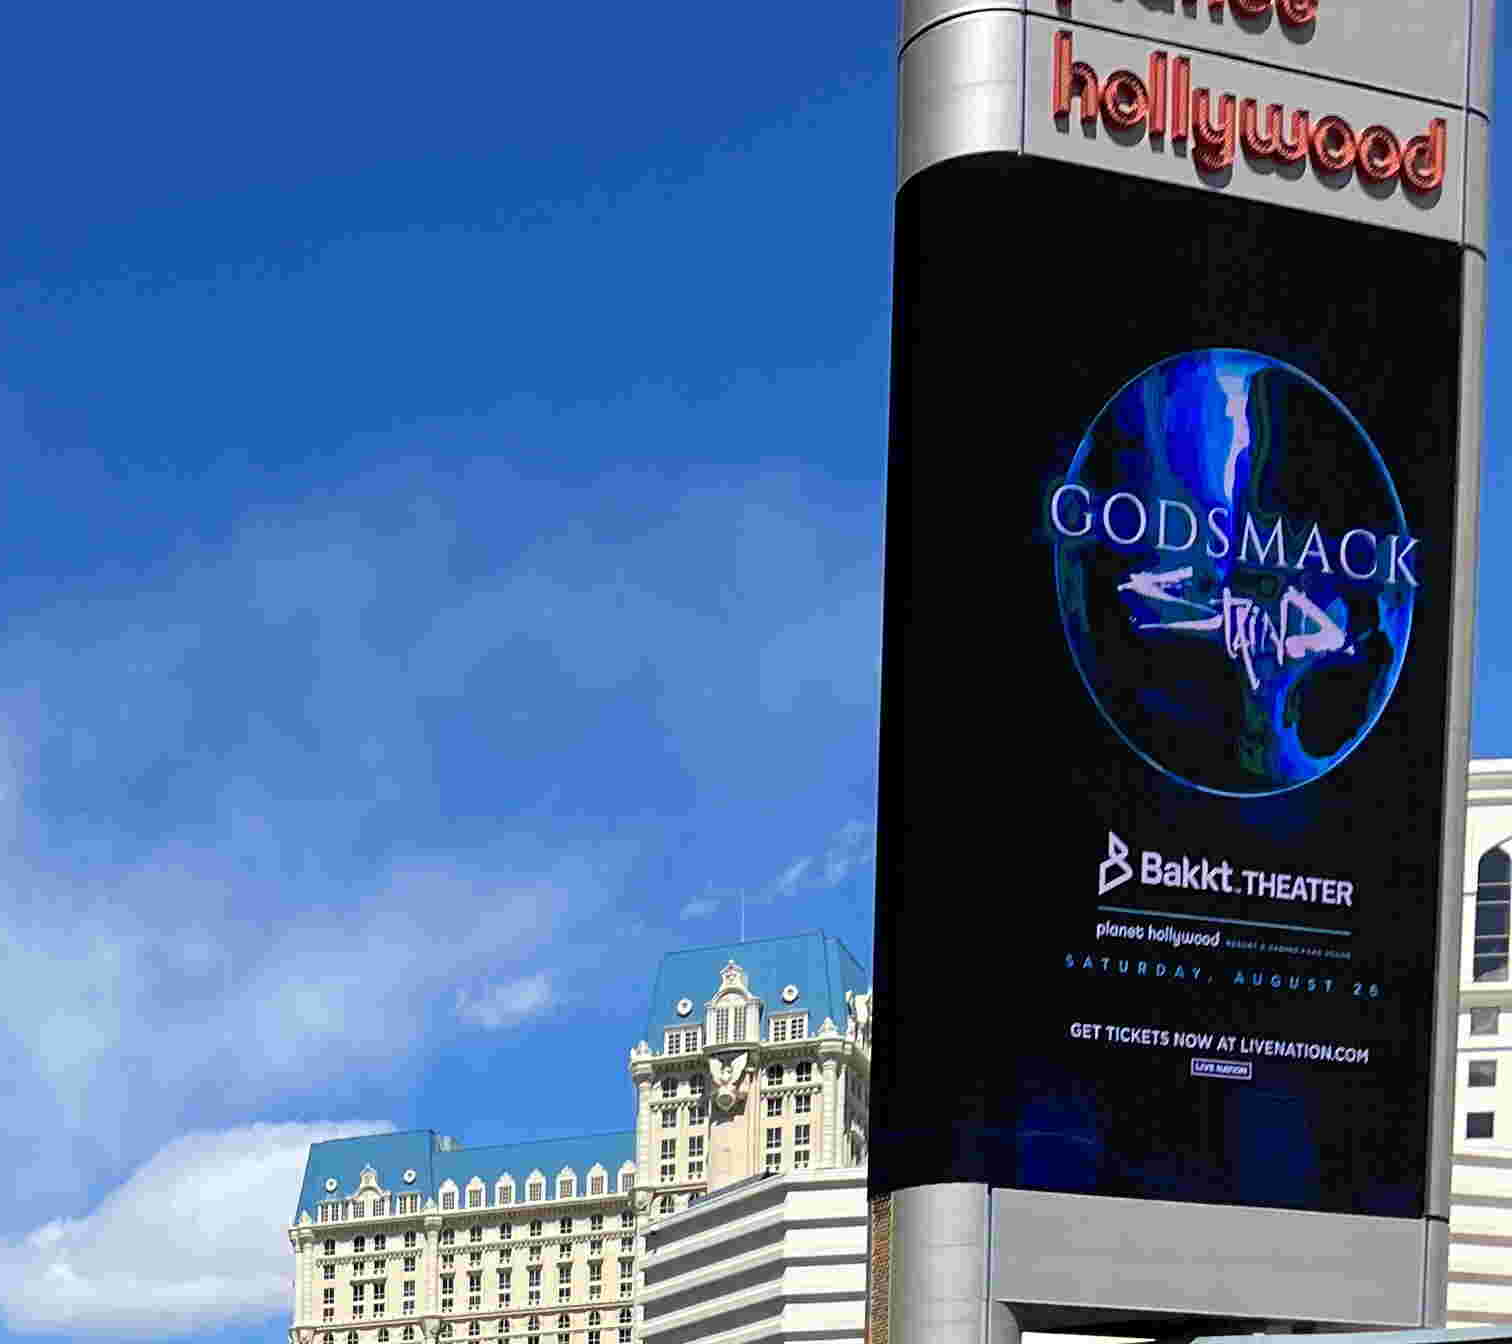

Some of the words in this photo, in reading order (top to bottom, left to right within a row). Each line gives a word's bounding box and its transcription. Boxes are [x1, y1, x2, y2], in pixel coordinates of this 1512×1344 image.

[1052, 30, 1448, 190] hollywood
[1051, 483, 1421, 587] GODSMACK
[1241, 869, 1354, 907] THEATER
[1095, 920, 1145, 940] planet
[1147, 923, 1221, 947] hollywood
[1232, 969, 1334, 992] AUGUST
[1070, 1022, 1102, 1040] GET
[1105, 1025, 1170, 1046] TICKETS
[1173, 1031, 1214, 1050] NOW
[1216, 1035, 1237, 1051] AT
[1239, 1036, 1370, 1065] LIVENATION.COM
